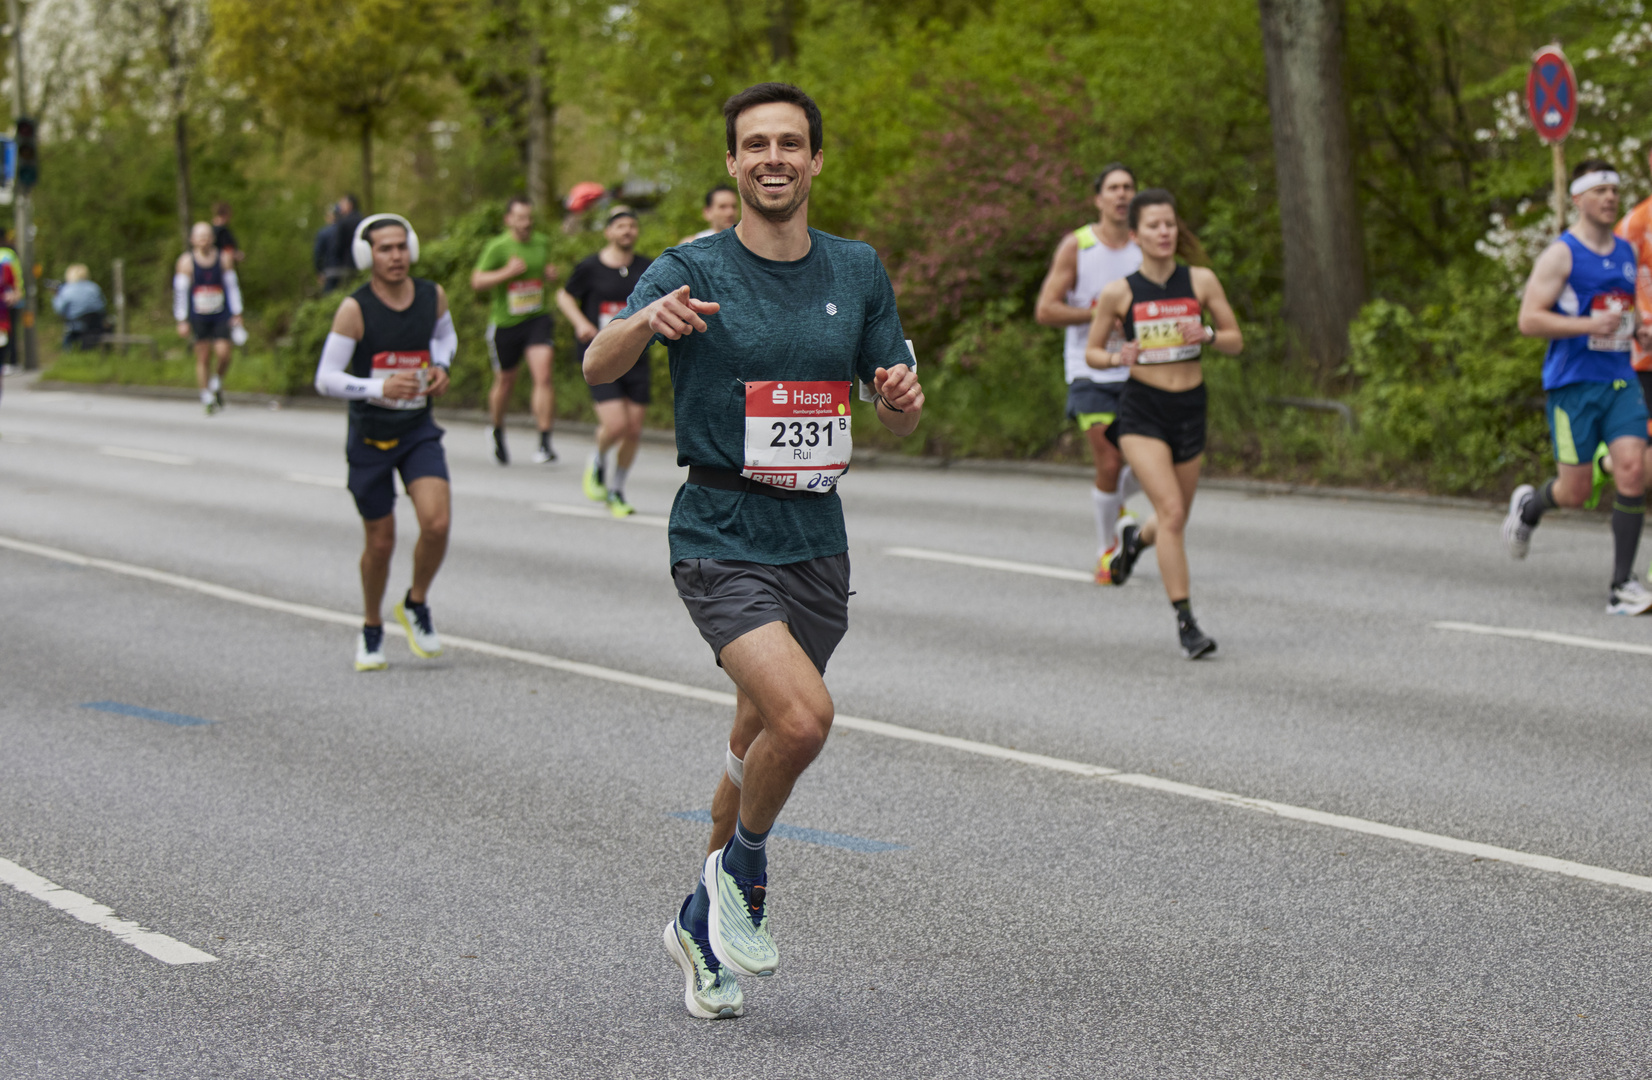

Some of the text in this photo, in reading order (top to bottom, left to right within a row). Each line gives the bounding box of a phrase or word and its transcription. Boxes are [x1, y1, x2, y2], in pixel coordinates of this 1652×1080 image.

[793, 390, 832, 408] Haspa
[839, 418, 847, 430] B
[770, 421, 833, 447] 2331
[793, 449, 812, 460] Rui
[751, 474, 795, 487] REWE
